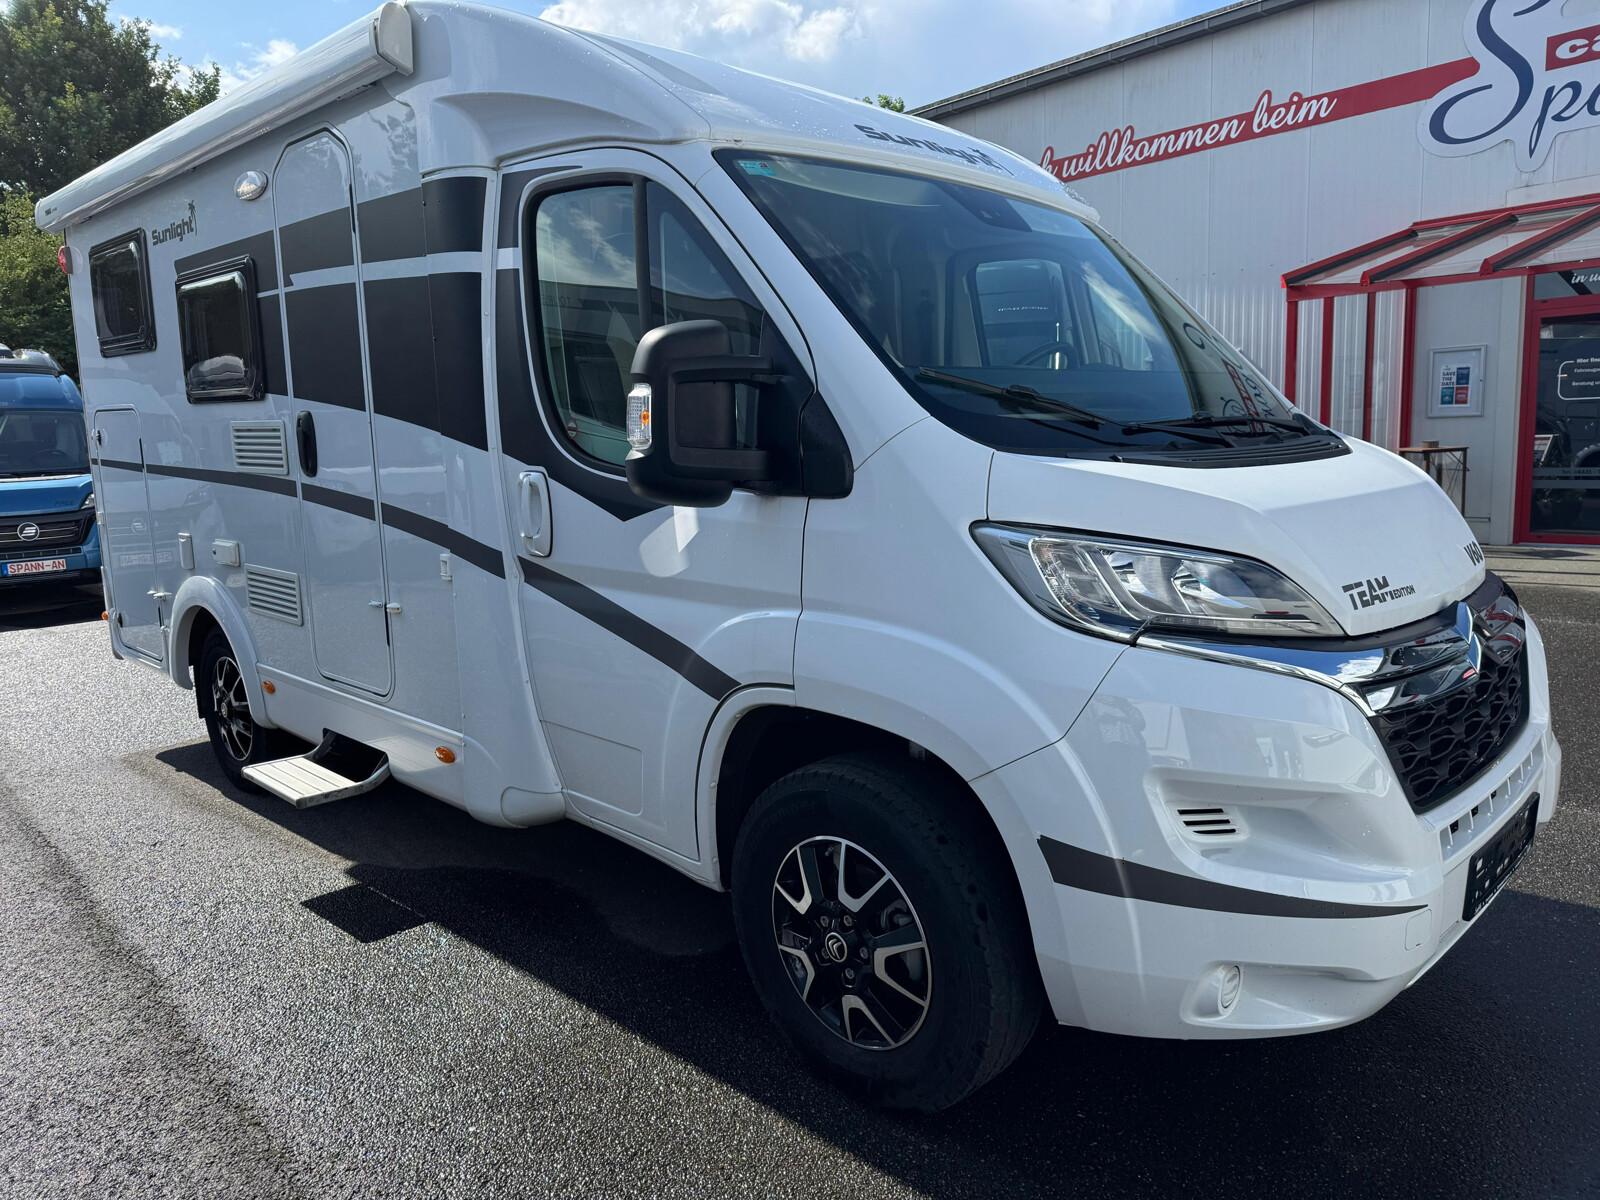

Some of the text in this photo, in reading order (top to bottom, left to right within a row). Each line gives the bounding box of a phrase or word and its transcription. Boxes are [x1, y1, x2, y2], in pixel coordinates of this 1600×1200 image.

[854, 124, 1003, 170] Sunlight
[1062, 119, 1246, 178] willkommen
[1252, 94, 1338, 133] beim
[152, 214, 195, 246] Sunlight
[8, 560, 65, 574] SPANN-AN
[1342, 575, 1416, 610] TEAM EDITION
